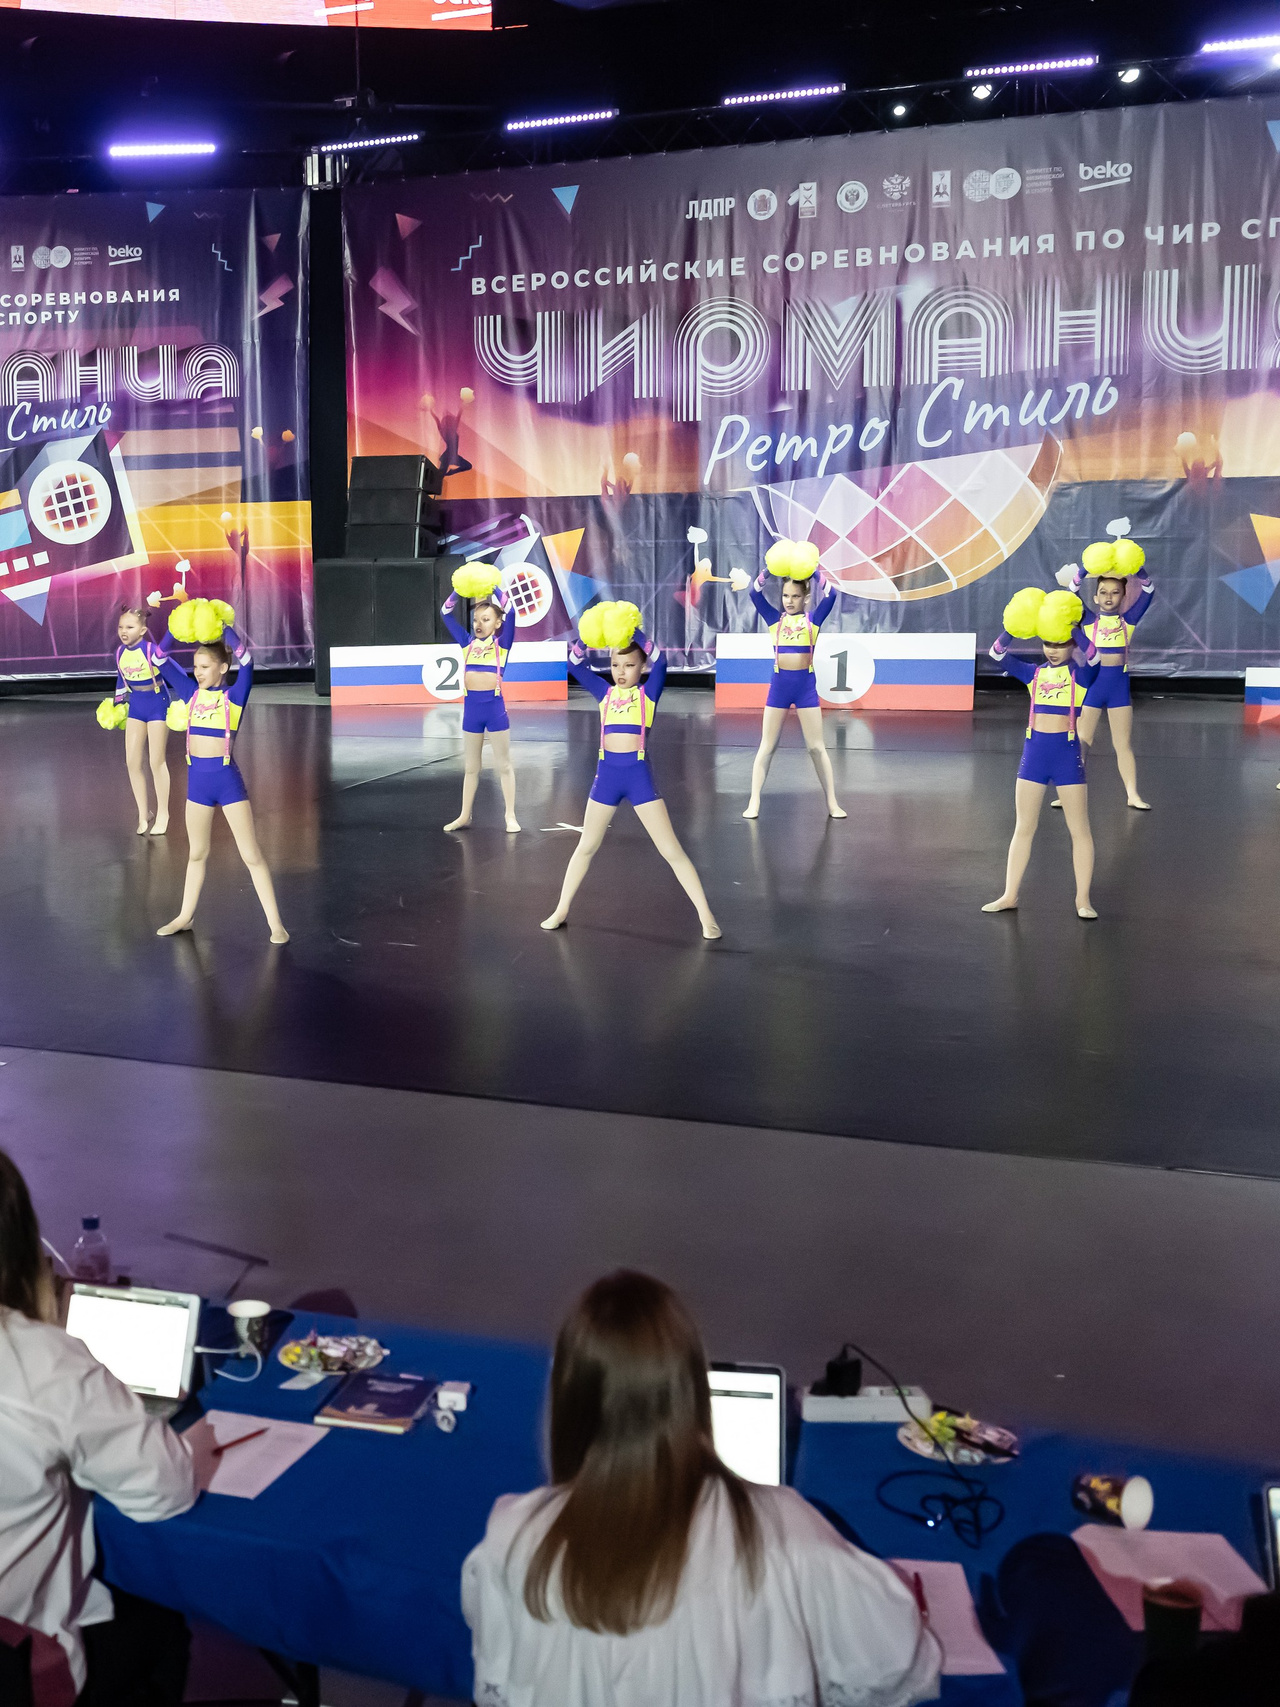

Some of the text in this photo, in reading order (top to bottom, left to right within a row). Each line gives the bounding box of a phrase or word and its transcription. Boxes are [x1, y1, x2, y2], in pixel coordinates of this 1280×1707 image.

[1078, 160, 1133, 181] beko
[685, 197, 736, 221] ЛДПР
[108, 245, 143, 258] beko
[471, 257, 746, 295] ВСЕРОССИЙСКИЕ
[762, 233, 1055, 274] СОРЕВНОВАНИЯ
[1075, 228, 1126, 251] ПО
[1144, 222, 1221, 246] ЧИР
[0, 288, 181, 308] СОРЕВНОВАНИЯ
[6, 401, 112, 442] Стиль
[703, 376, 1120, 486] Ретро Стиль
[435, 656, 460, 691] 2
[829, 649, 853, 692] 1
